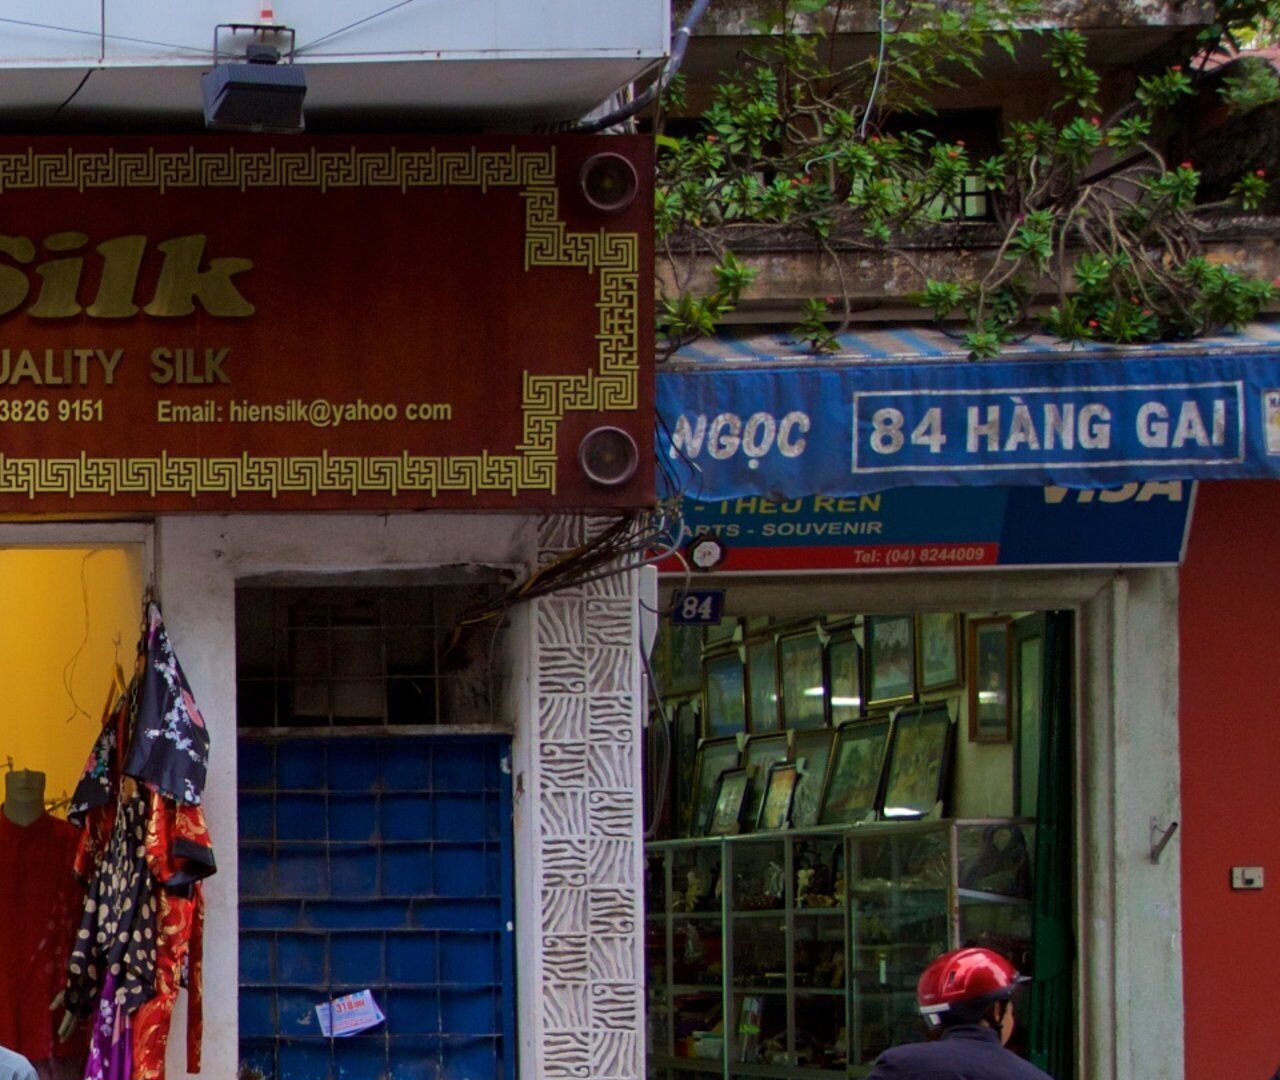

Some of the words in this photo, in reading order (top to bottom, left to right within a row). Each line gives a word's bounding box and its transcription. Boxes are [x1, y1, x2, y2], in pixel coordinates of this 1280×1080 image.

[151, 347, 231, 385] SILK
[58, 401, 104, 422] 9151
[157, 400, 223, 424] Email:
[668, 411, 811, 469] NGỌC
[870, 407, 946, 454] 84
[966, 396, 1112, 453] HÀNG
[1136, 400, 1225, 448] GAI
[762, 522, 883, 537] SOUVENIR
[853, 550, 880, 563] Tel:
[885, 549, 915, 565] (04)
[920, 547, 985, 562] 8244009
[681, 596, 713, 619] 84
